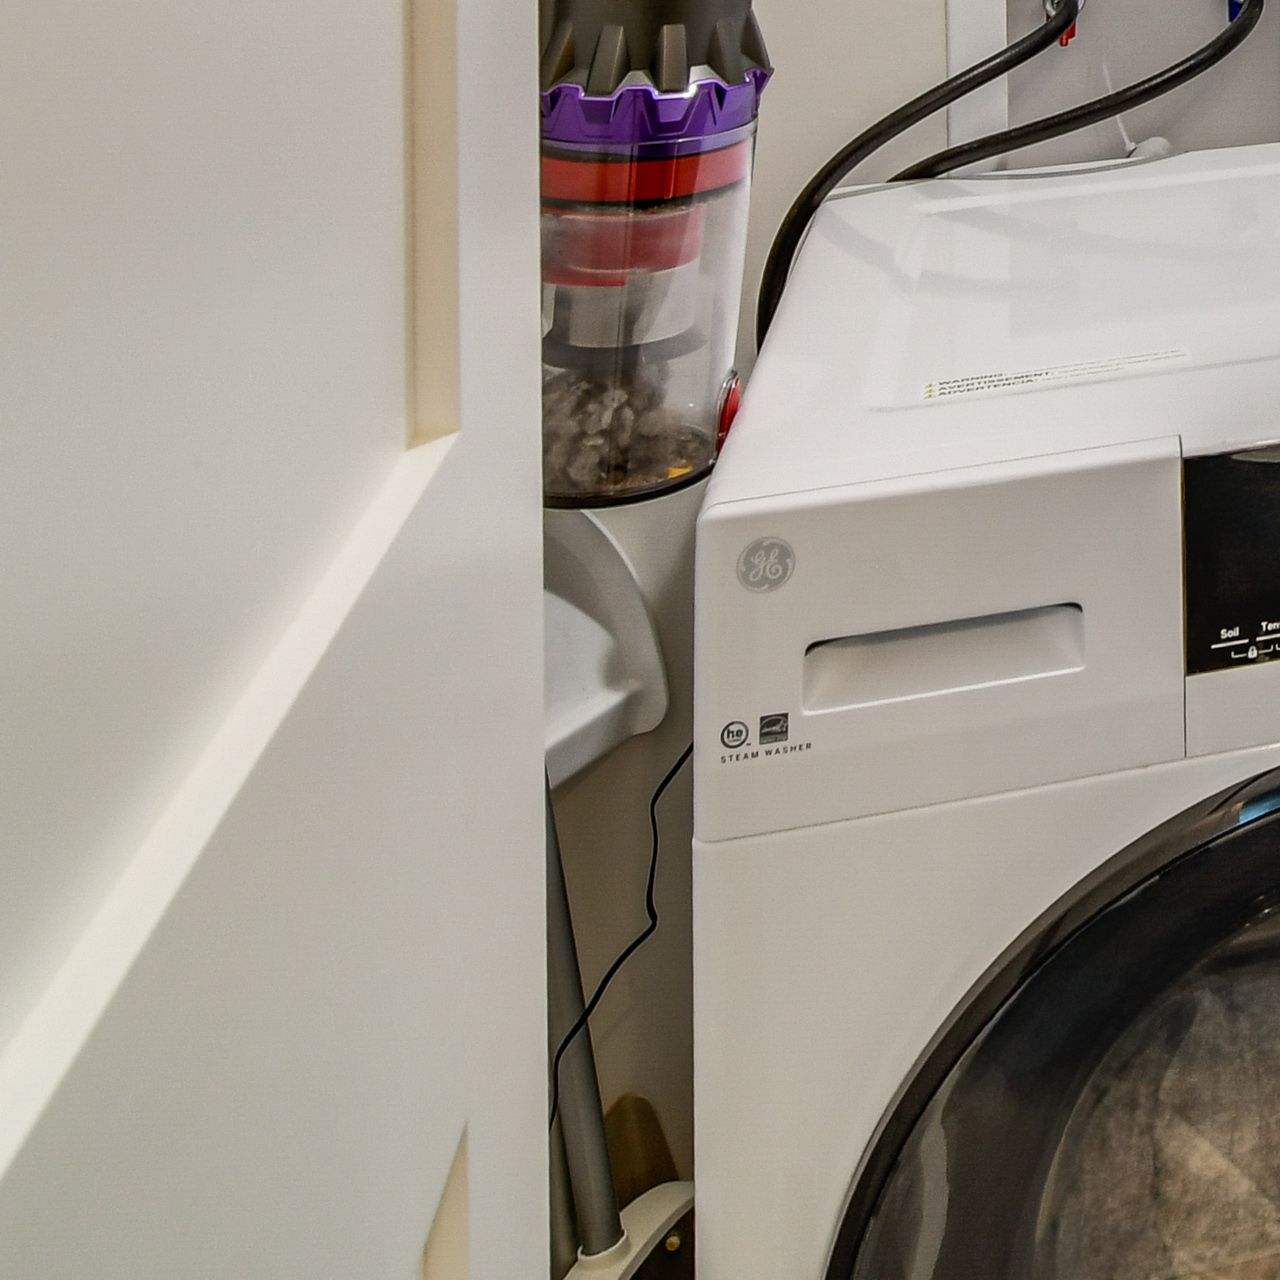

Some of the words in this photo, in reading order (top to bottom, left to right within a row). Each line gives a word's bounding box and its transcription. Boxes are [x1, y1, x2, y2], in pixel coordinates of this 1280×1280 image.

[1221, 627, 1239, 639] Soil
[721, 751, 759, 763] STEAM
[765, 743, 812, 756] WASHER
